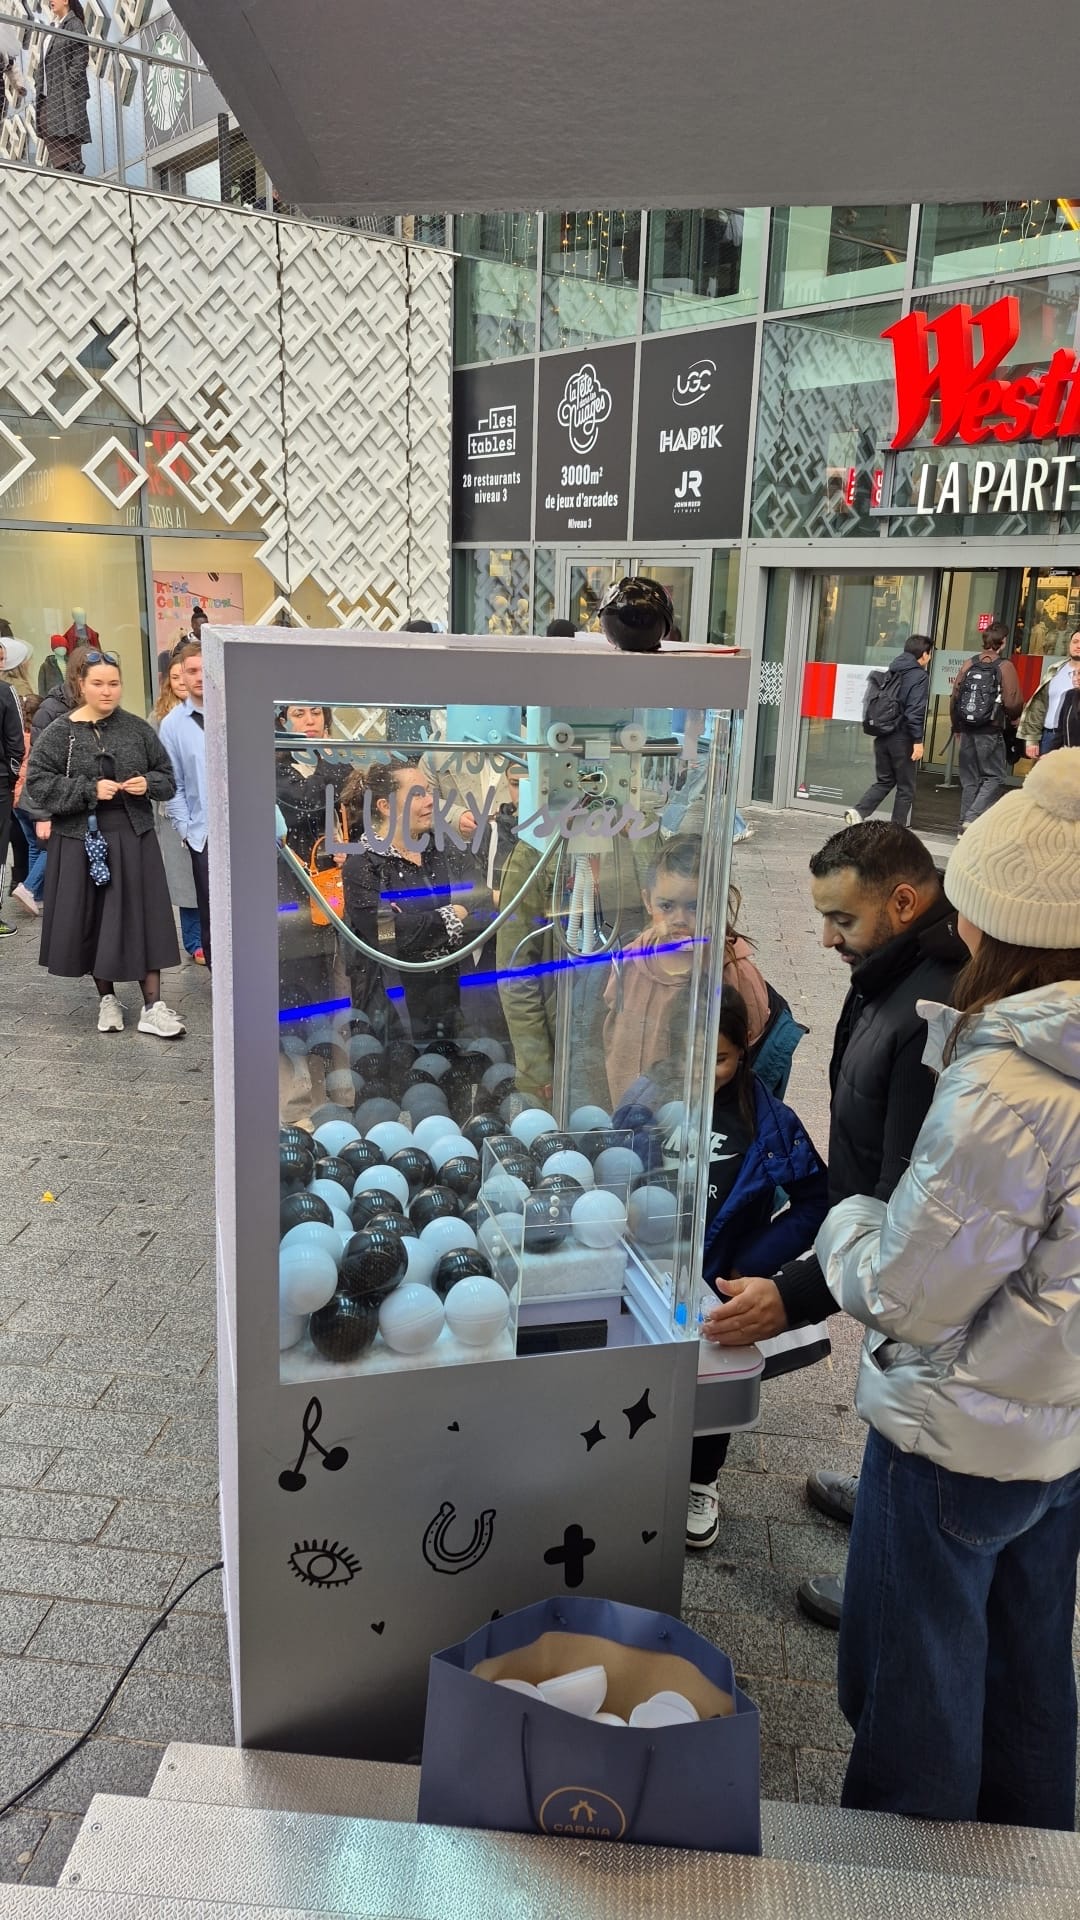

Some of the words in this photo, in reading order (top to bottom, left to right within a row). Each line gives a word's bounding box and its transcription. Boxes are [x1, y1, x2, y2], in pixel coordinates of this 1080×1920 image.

[677, 369, 712, 394] UGC
[492, 413, 513, 429] les
[471, 436, 513, 454] tables
[462, 474, 472, 488] 28
[473, 471, 521, 487] restaurants
[674, 470, 702, 498] JR
[917, 461, 960, 514] LA
[474, 489, 501, 504] niveau
[502, 488, 508, 502] 3
[545, 494, 556, 509] de
[556, 493, 575, 512] jeux
[575, 491, 619, 508] d'arcades
[587, 517, 593, 529] 3
[324, 783, 496, 855] LUCKY
[511, 797, 659, 840] star
